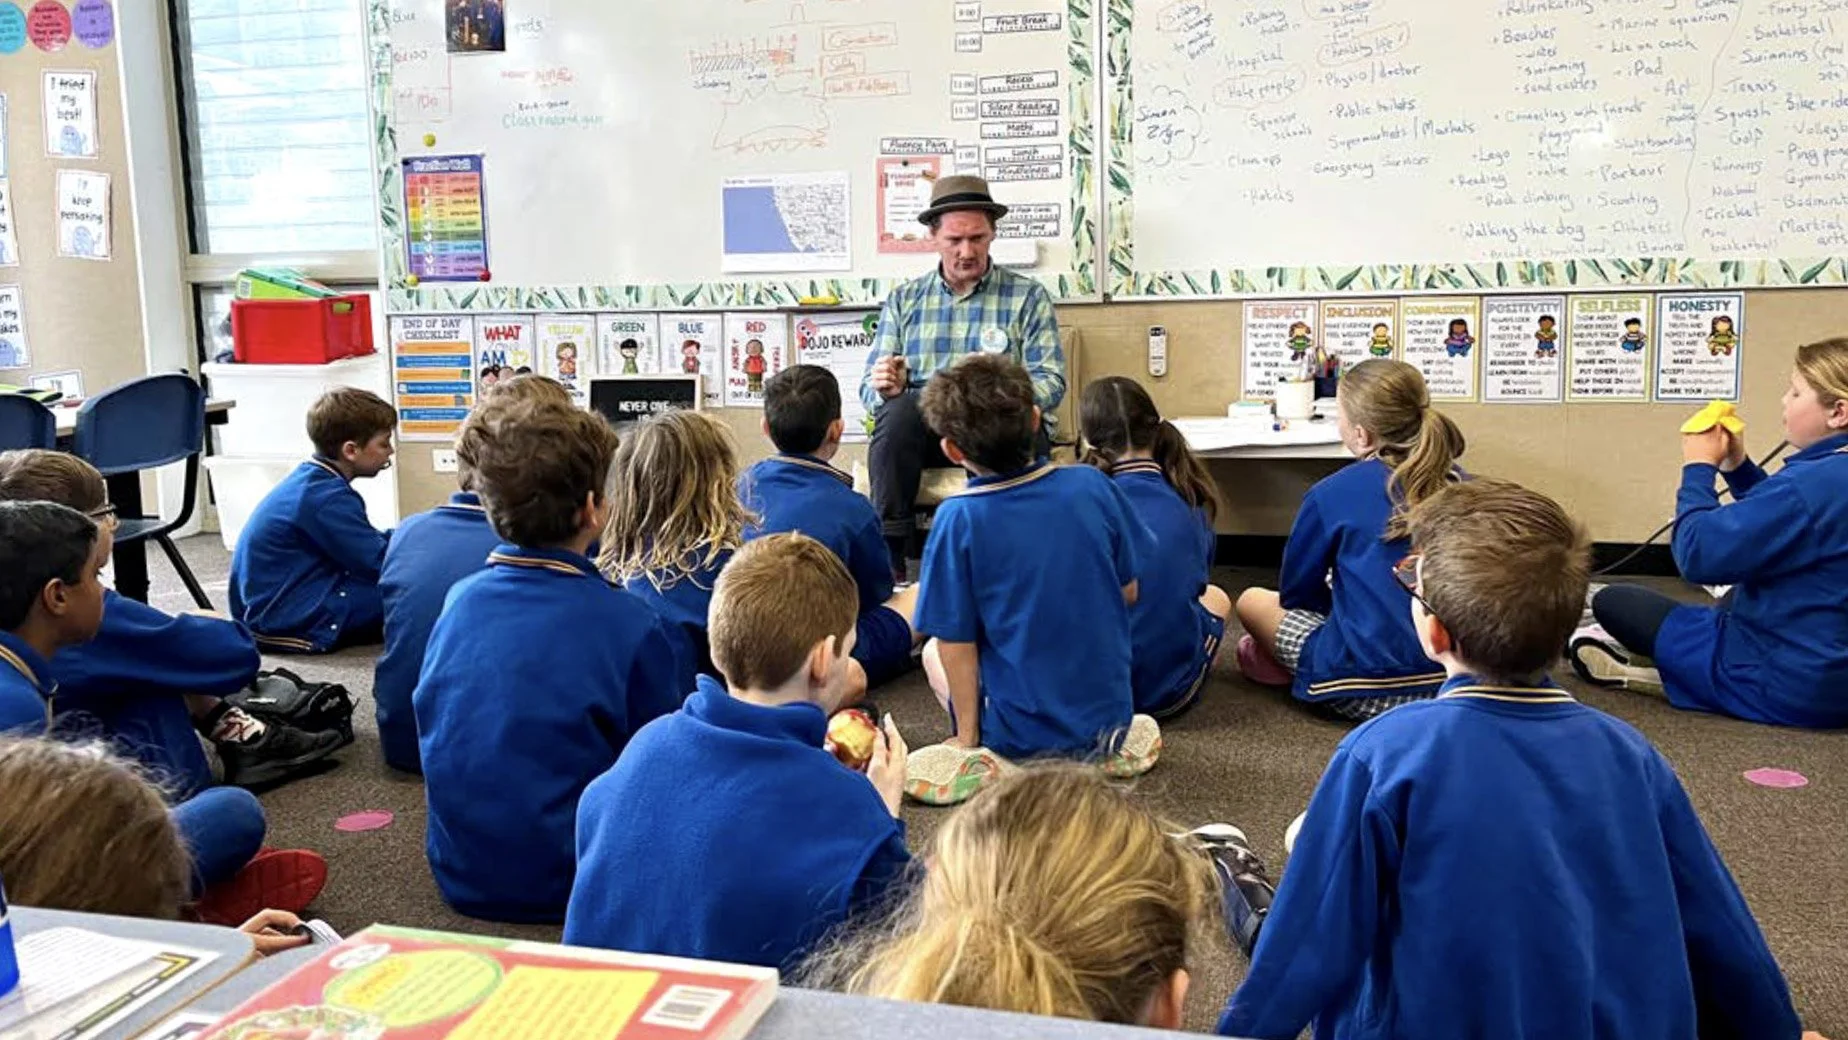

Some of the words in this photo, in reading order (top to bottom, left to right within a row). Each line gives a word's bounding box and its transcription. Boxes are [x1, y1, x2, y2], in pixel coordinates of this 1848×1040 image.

[996, 17, 1018, 25] Fruit
[1022, 15, 1047, 24] Break
[1670, 13, 1729, 31] aquarium
[1502, 26, 1556, 44] Beaches
[1225, 43, 1284, 70] Hospital
[1741, 48, 1808, 63] Swimming
[1525, 62, 1586, 76] swimming
[1627, 57, 1663, 76] iPad
[59, 78, 85, 91] tried
[1006, 75, 1033, 84] Recess
[1726, 78, 1777, 93] Tennis
[61, 95, 76, 106] my
[988, 103, 1013, 111] Silent
[1017, 102, 1052, 113] Reading
[1336, 102, 1371, 119] Public
[1505, 108, 1567, 123] Connecting
[1714, 106, 1771, 128] Squash
[1006, 123, 1032, 132] Maths
[1422, 119, 1476, 137] Markets
[1730, 127, 1764, 148] Golf
[889, 140, 924, 150] Fluency
[926, 140, 947, 148] Pairs
[1012, 148, 1039, 156] Lunch
[1479, 148, 1510, 166] Lego
[1788, 142, 1818, 167] Ping
[1313, 162, 1375, 179] Emergency
[1457, 171, 1508, 189] Reading
[1704, 202, 1760, 221] Cricket
[1524, 220, 1548, 235] the
[1556, 217, 1586, 242] dog
[1252, 308, 1308, 319] RESPECT
[1326, 307, 1393, 318] INCLUSION
[1488, 303, 1560, 313] POSITIVITY
[1579, 301, 1641, 312] SELFLESS
[1669, 301, 1731, 312] HONESTY
[402, 319, 423, 329] END
[425, 319, 438, 329] OF
[441, 319, 462, 328] DAY
[611, 322, 645, 333] GREEN
[678, 322, 704, 334] BLUE
[745, 321, 766, 333] RED
[404, 330, 460, 340] CHECKLIST
[484, 325, 522, 341] WHAT
[800, 336, 829, 351] DOJO
[481, 351, 506, 366] AM
[728, 378, 746, 387] MAD
[618, 401, 648, 412] NEVER
